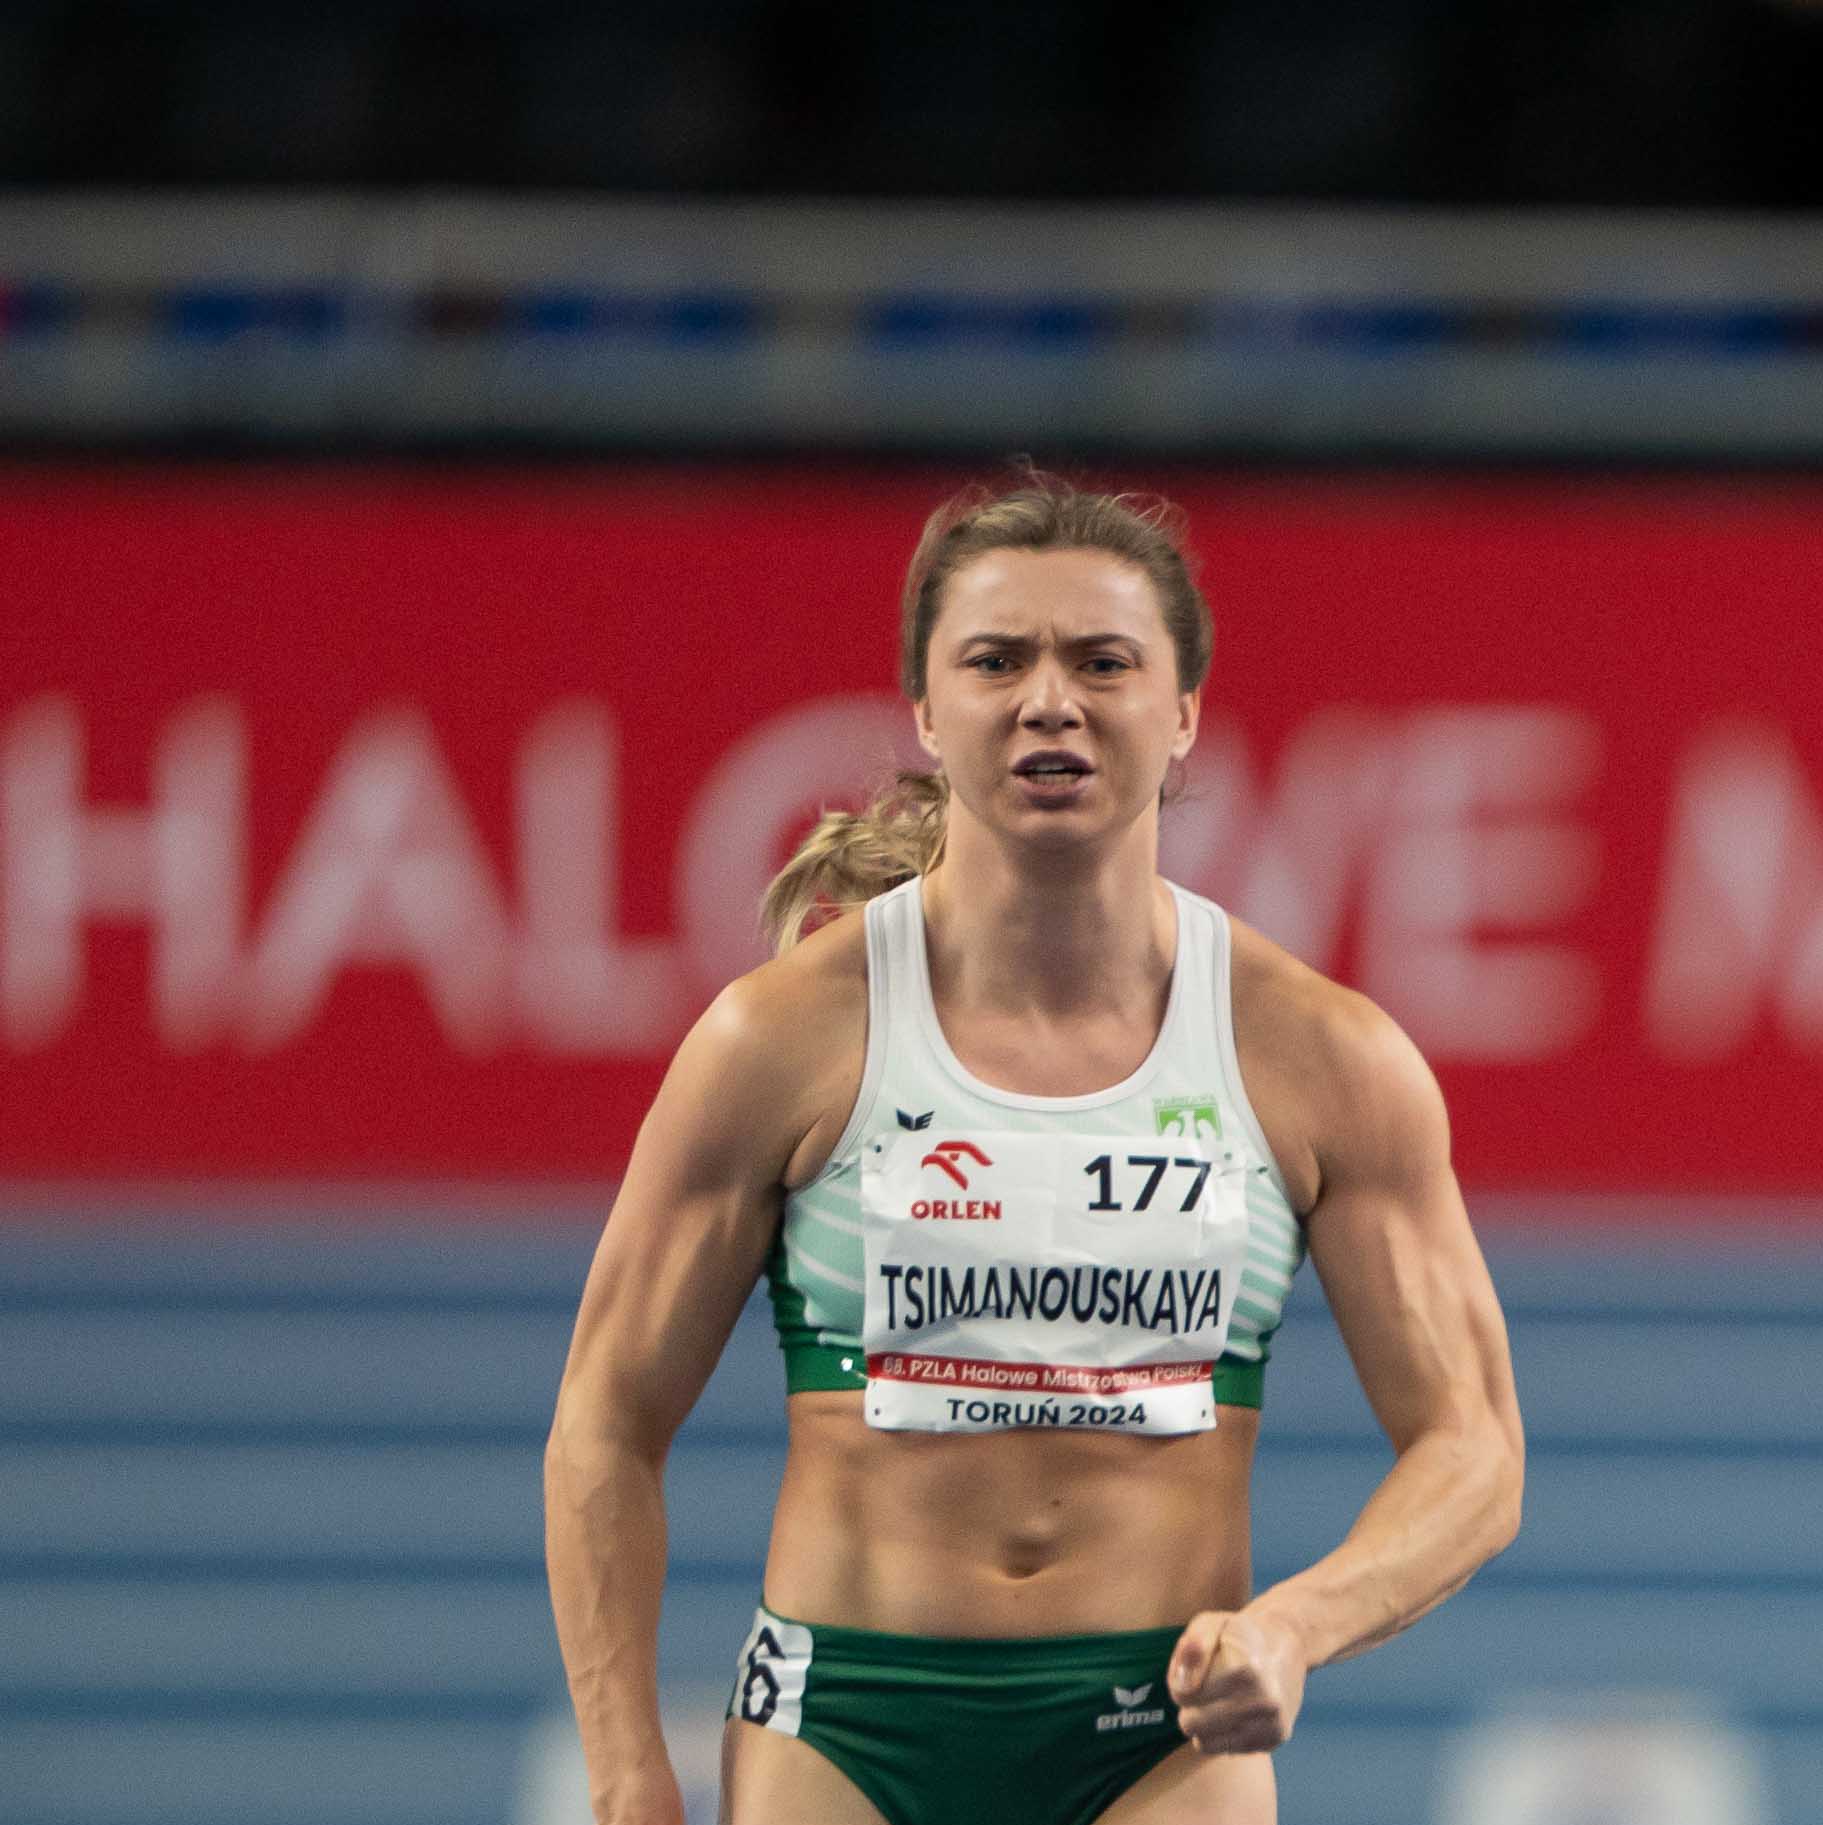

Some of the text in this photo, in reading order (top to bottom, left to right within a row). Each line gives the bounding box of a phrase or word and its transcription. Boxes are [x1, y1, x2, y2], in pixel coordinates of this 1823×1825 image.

[1084, 1155, 1212, 1212] 177
[911, 1200, 1002, 1220] ORLEN
[880, 1263, 1221, 1335] TSIMANOUSKAYA
[909, 1359, 957, 1380] PZLA
[961, 1364, 1038, 1385] Halowe
[1043, 1368, 1151, 1389] Mistrzostwa
[946, 1397, 1148, 1425] TORUŃ 2024
[742, 1626, 785, 1727] 6
[1096, 1708, 1165, 1731] erima
